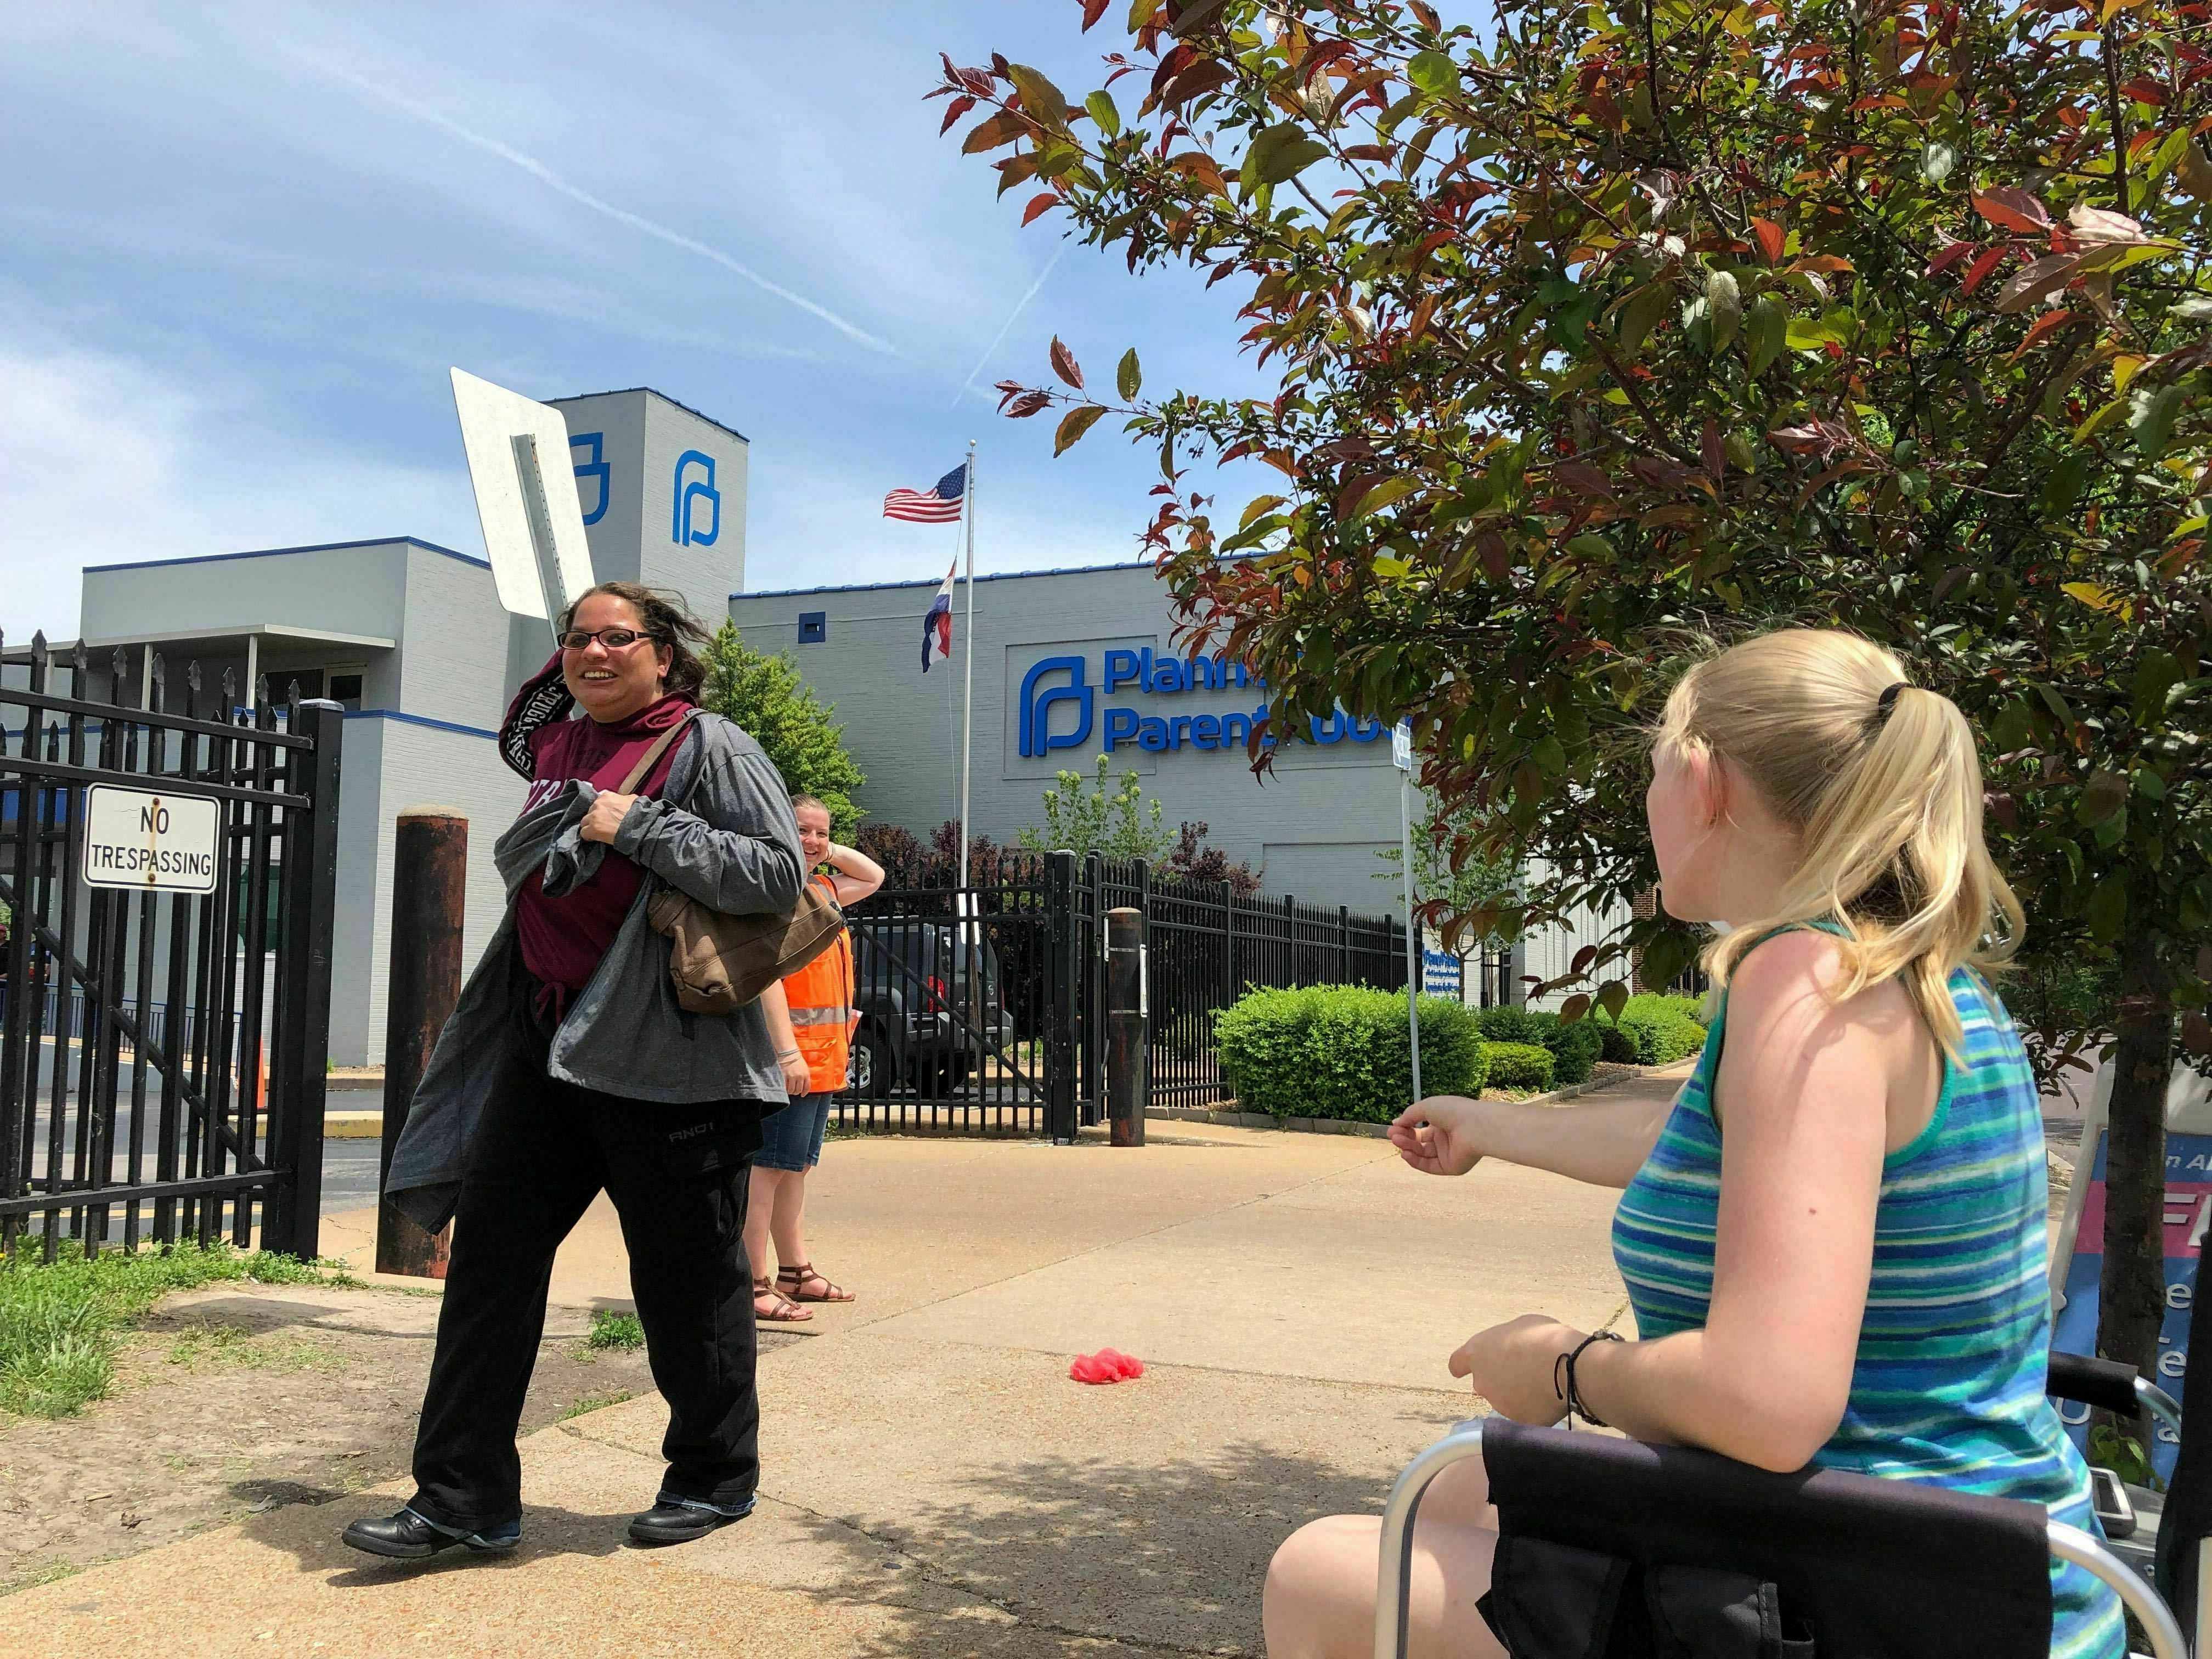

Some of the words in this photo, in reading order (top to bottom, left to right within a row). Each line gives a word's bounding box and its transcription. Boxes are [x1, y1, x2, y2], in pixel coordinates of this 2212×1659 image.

[1104, 647, 1305, 693] Plann
[515, 686, 563, 732] STRUGGE
[1104, 699, 1412, 752] Parentoo
[140, 806, 169, 834] NO
[92, 844, 211, 876] TRESPASSING
